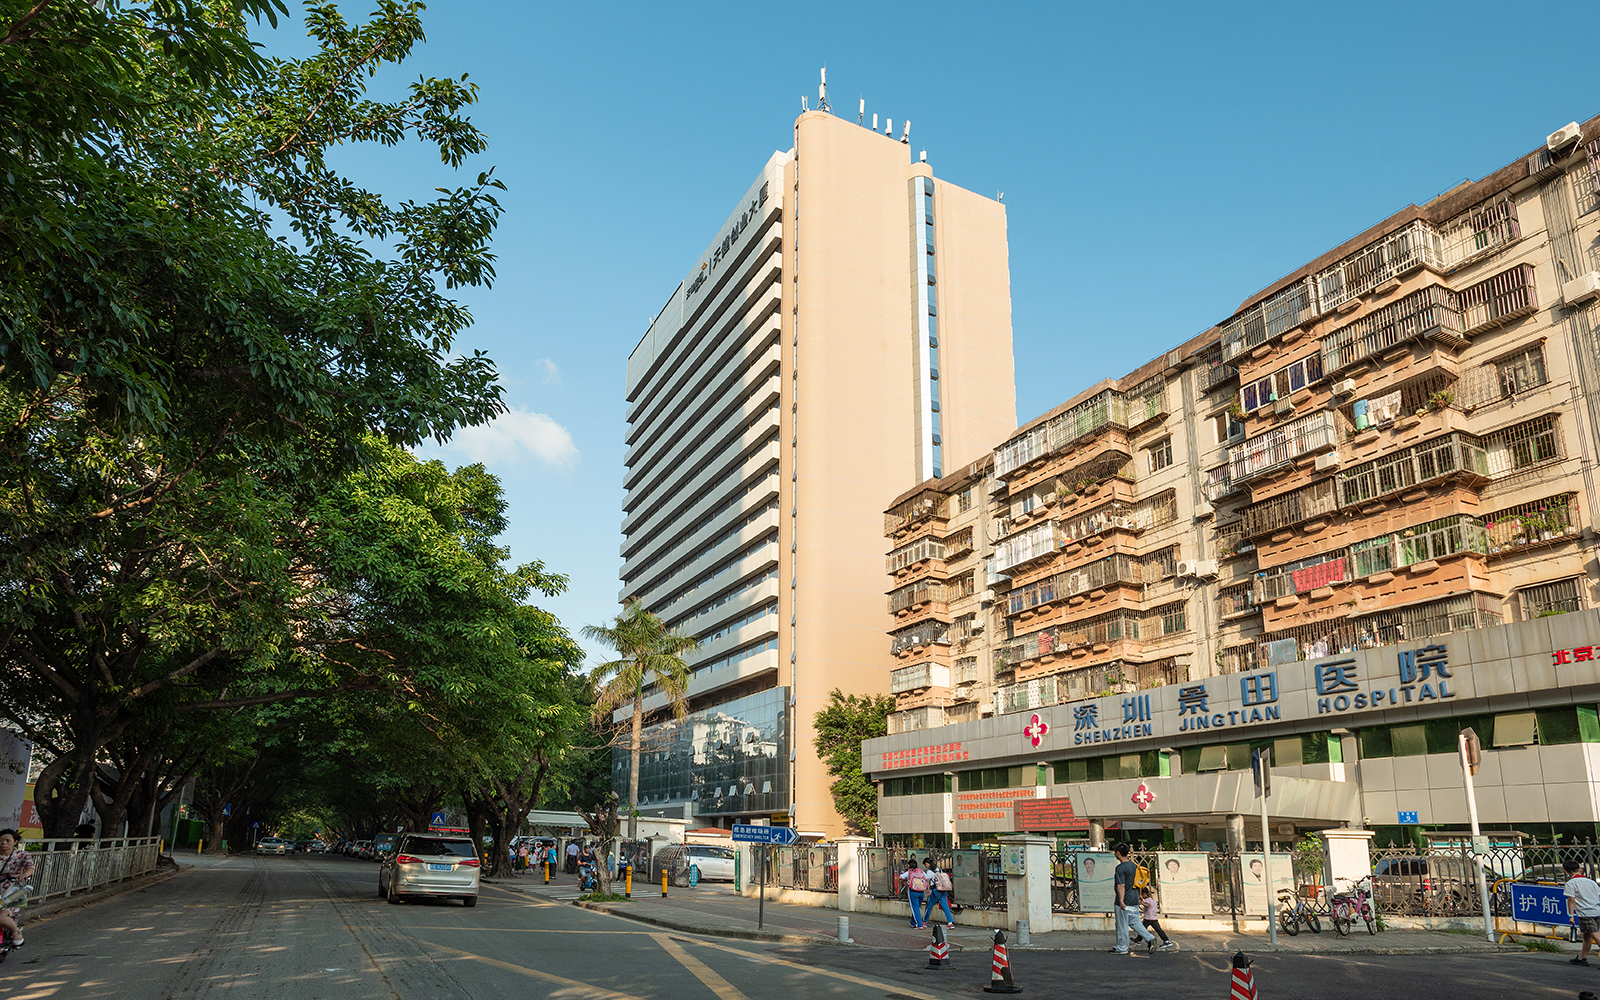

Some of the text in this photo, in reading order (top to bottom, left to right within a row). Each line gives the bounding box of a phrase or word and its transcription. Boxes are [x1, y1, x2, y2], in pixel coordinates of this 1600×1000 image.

[1552, 645, 1600, 667] 北京
[1073, 644, 1453, 731] 深圳景田医院
[1074, 680, 1456, 745] SHENZHEN JINGTIAN HOSPITAL
[733, 826, 770, 835] 应急避难场所
